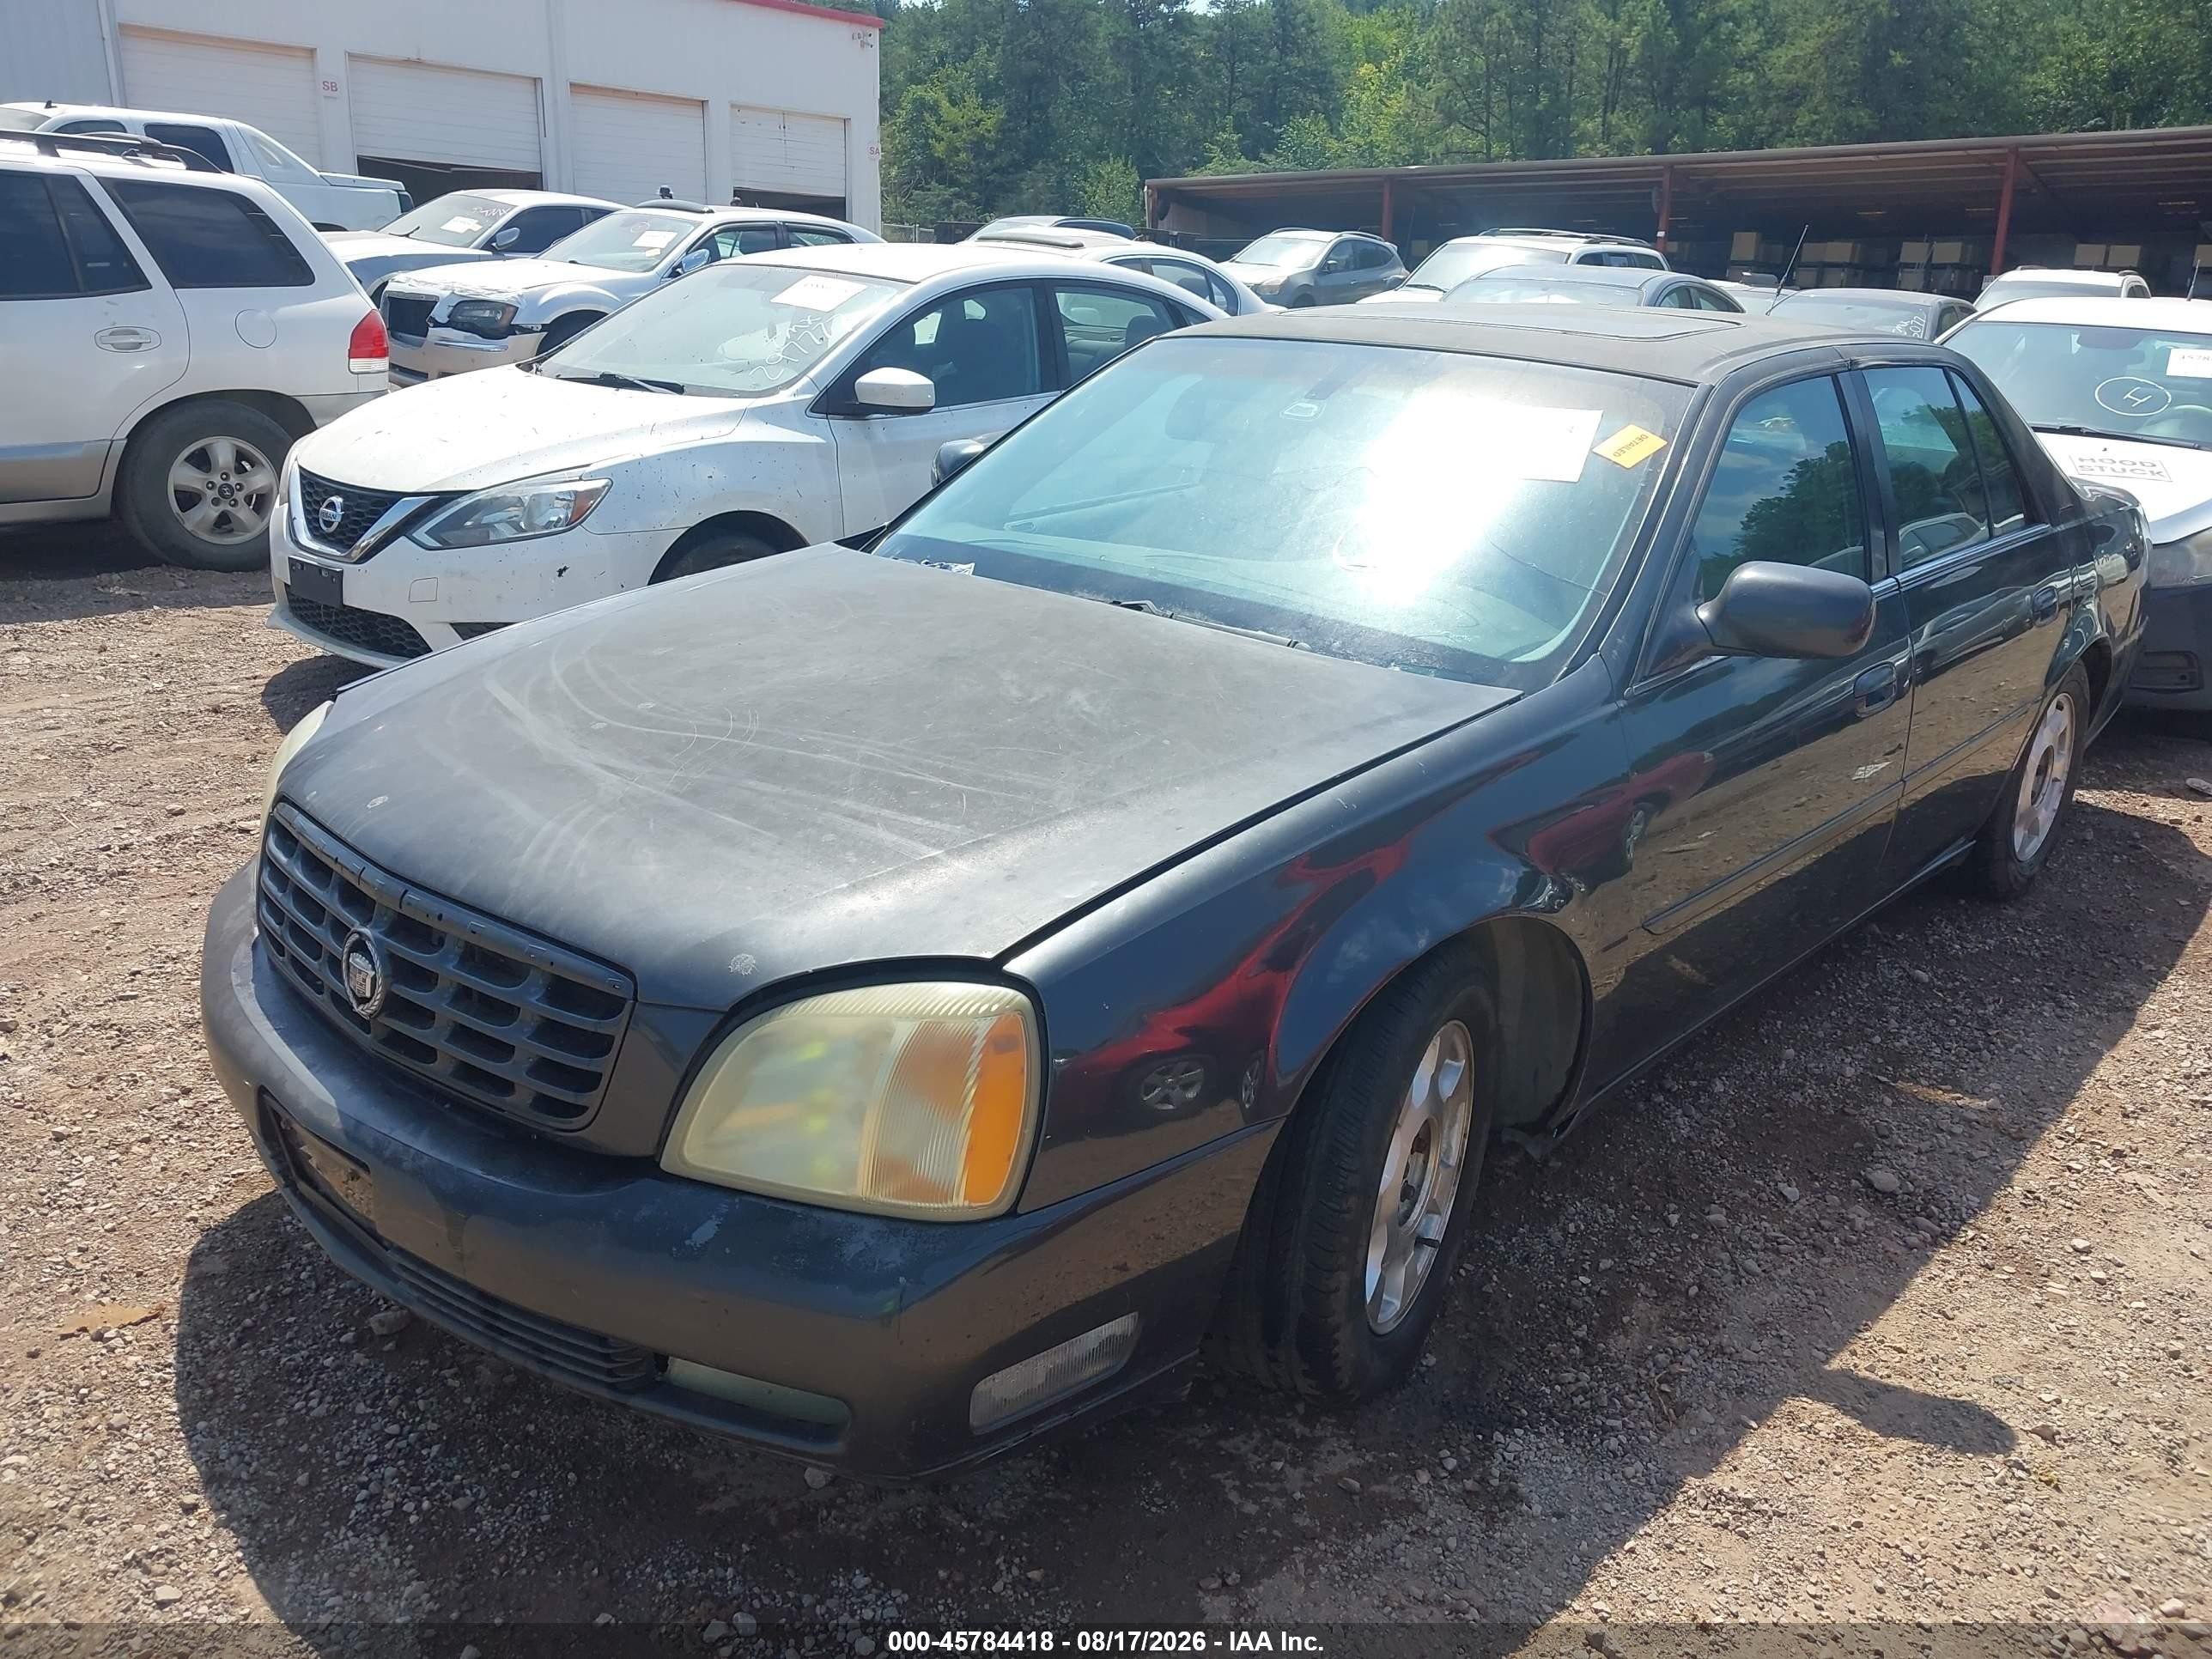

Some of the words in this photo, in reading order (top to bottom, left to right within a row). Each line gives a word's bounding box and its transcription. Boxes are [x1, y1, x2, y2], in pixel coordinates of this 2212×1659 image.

[322, 81, 338, 92] SB
[869, 146, 880, 155] SA
[1613, 434, 1649, 458] DETAILED
[2078, 457, 2157, 468] HOOD
[2078, 465, 2166, 477] STUCK
